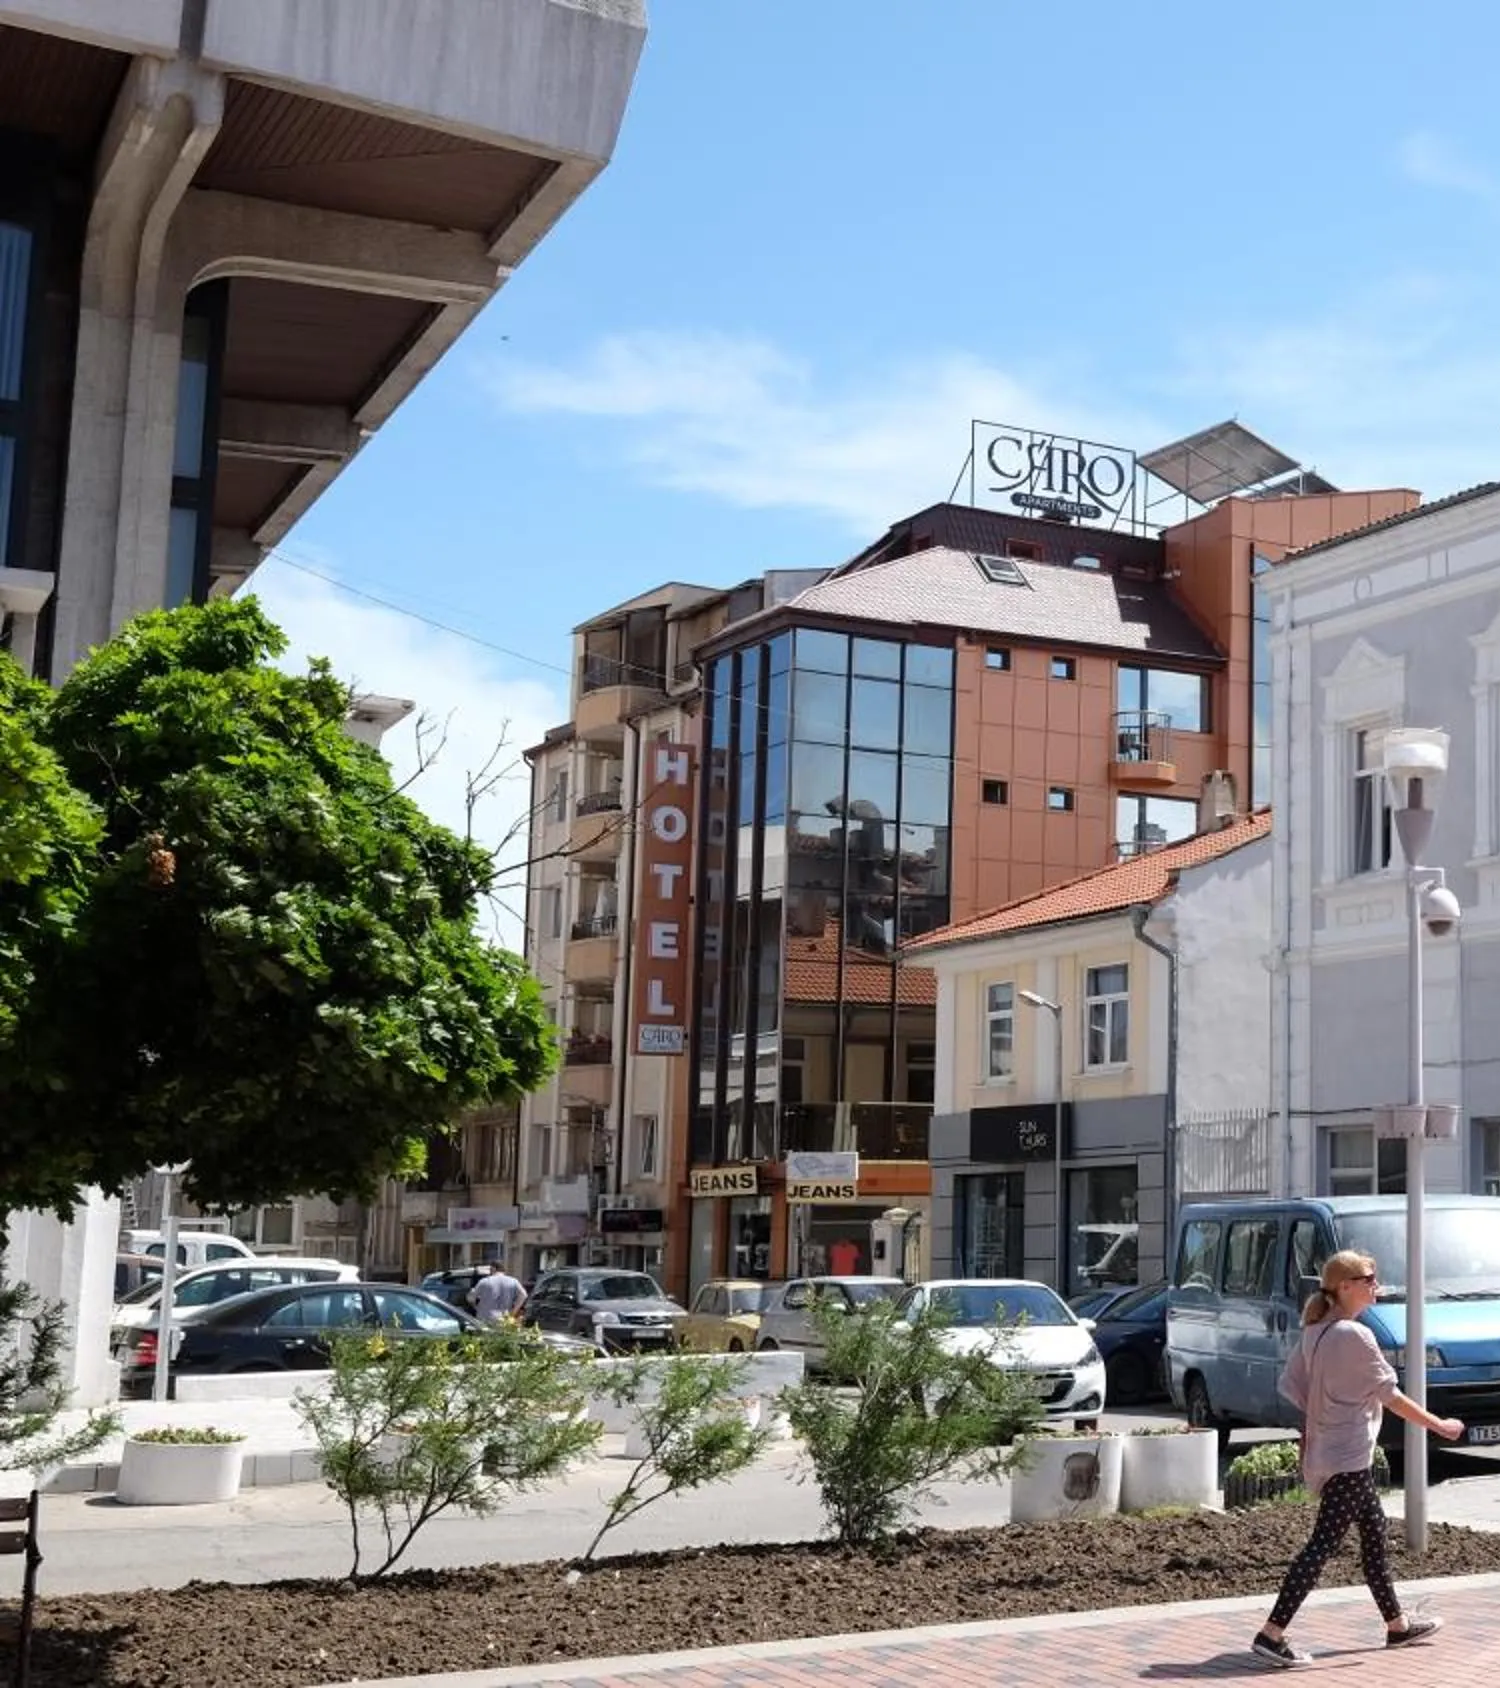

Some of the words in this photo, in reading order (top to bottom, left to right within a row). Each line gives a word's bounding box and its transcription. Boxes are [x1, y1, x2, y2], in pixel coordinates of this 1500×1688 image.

[647, 750, 688, 1015] HOTEL
[693, 1173, 754, 1192] JEANS
[788, 1184, 855, 1199] JEANS
